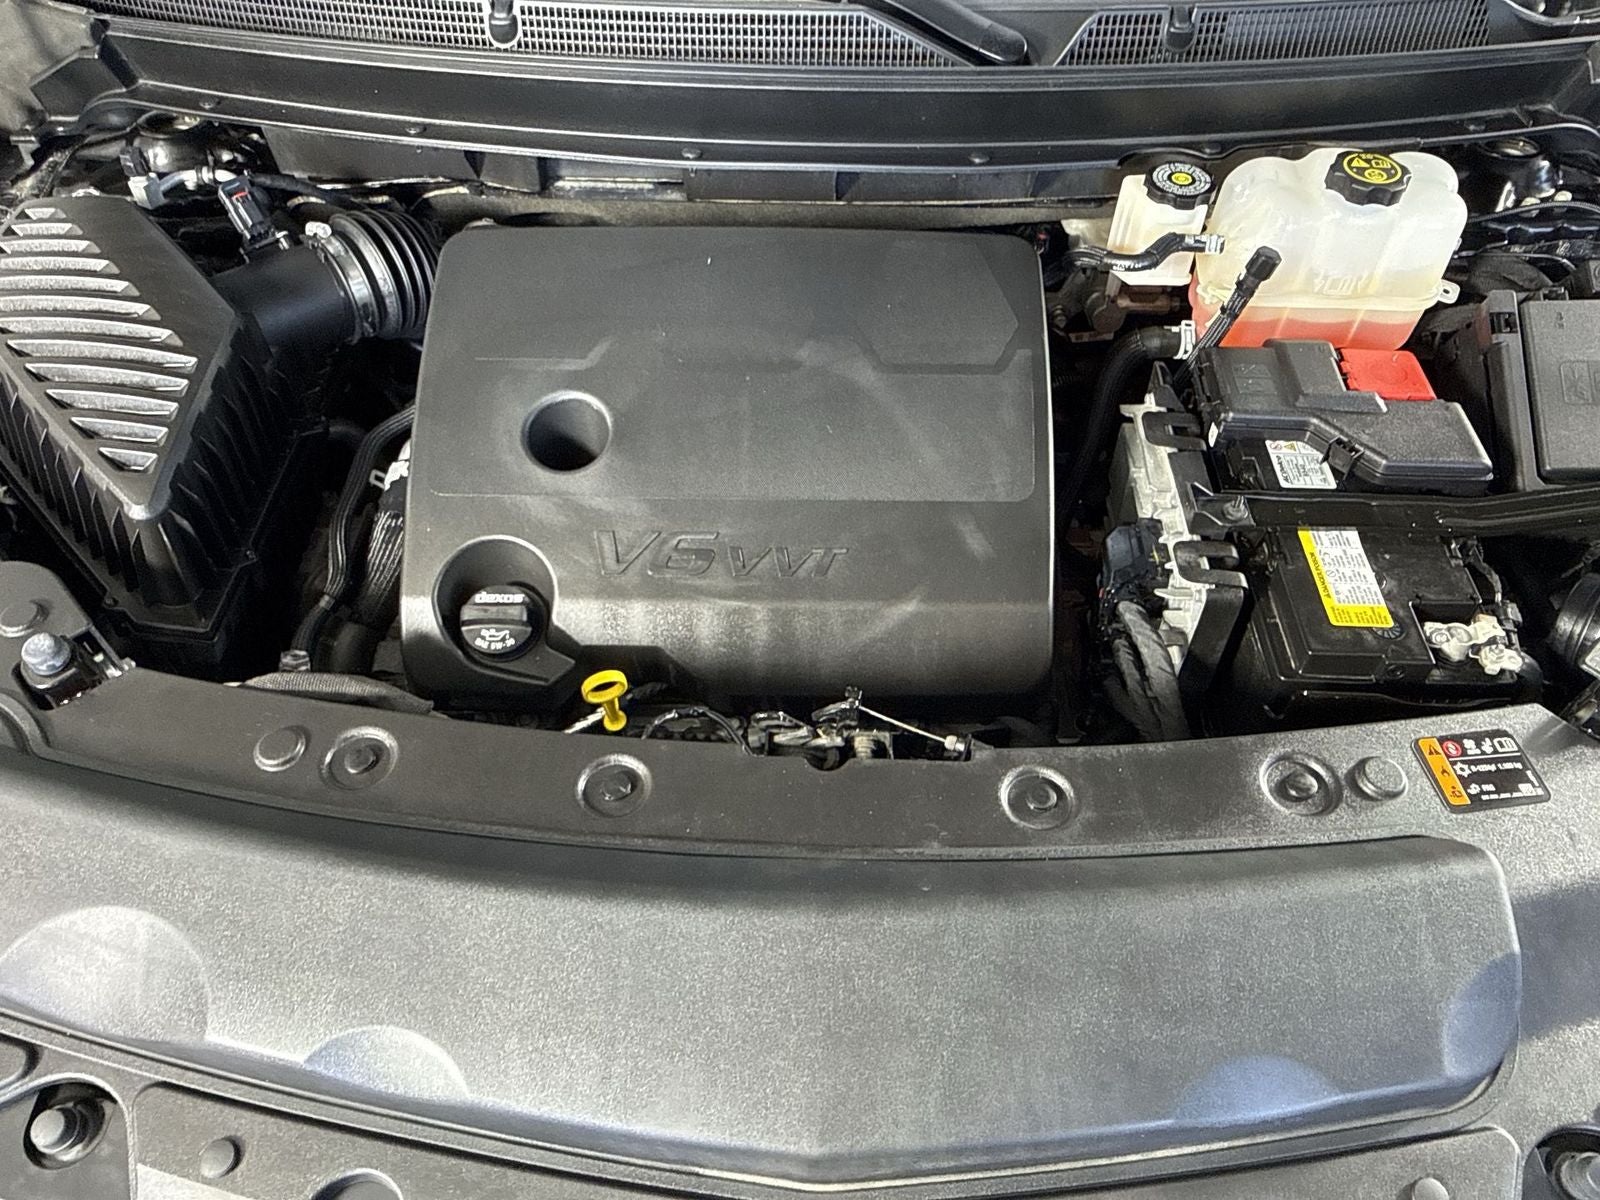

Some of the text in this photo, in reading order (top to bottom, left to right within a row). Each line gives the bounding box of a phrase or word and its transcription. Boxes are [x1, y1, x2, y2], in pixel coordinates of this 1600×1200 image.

[593, 529, 850, 578] V6 VVT
[474, 591, 526, 604] dexos
